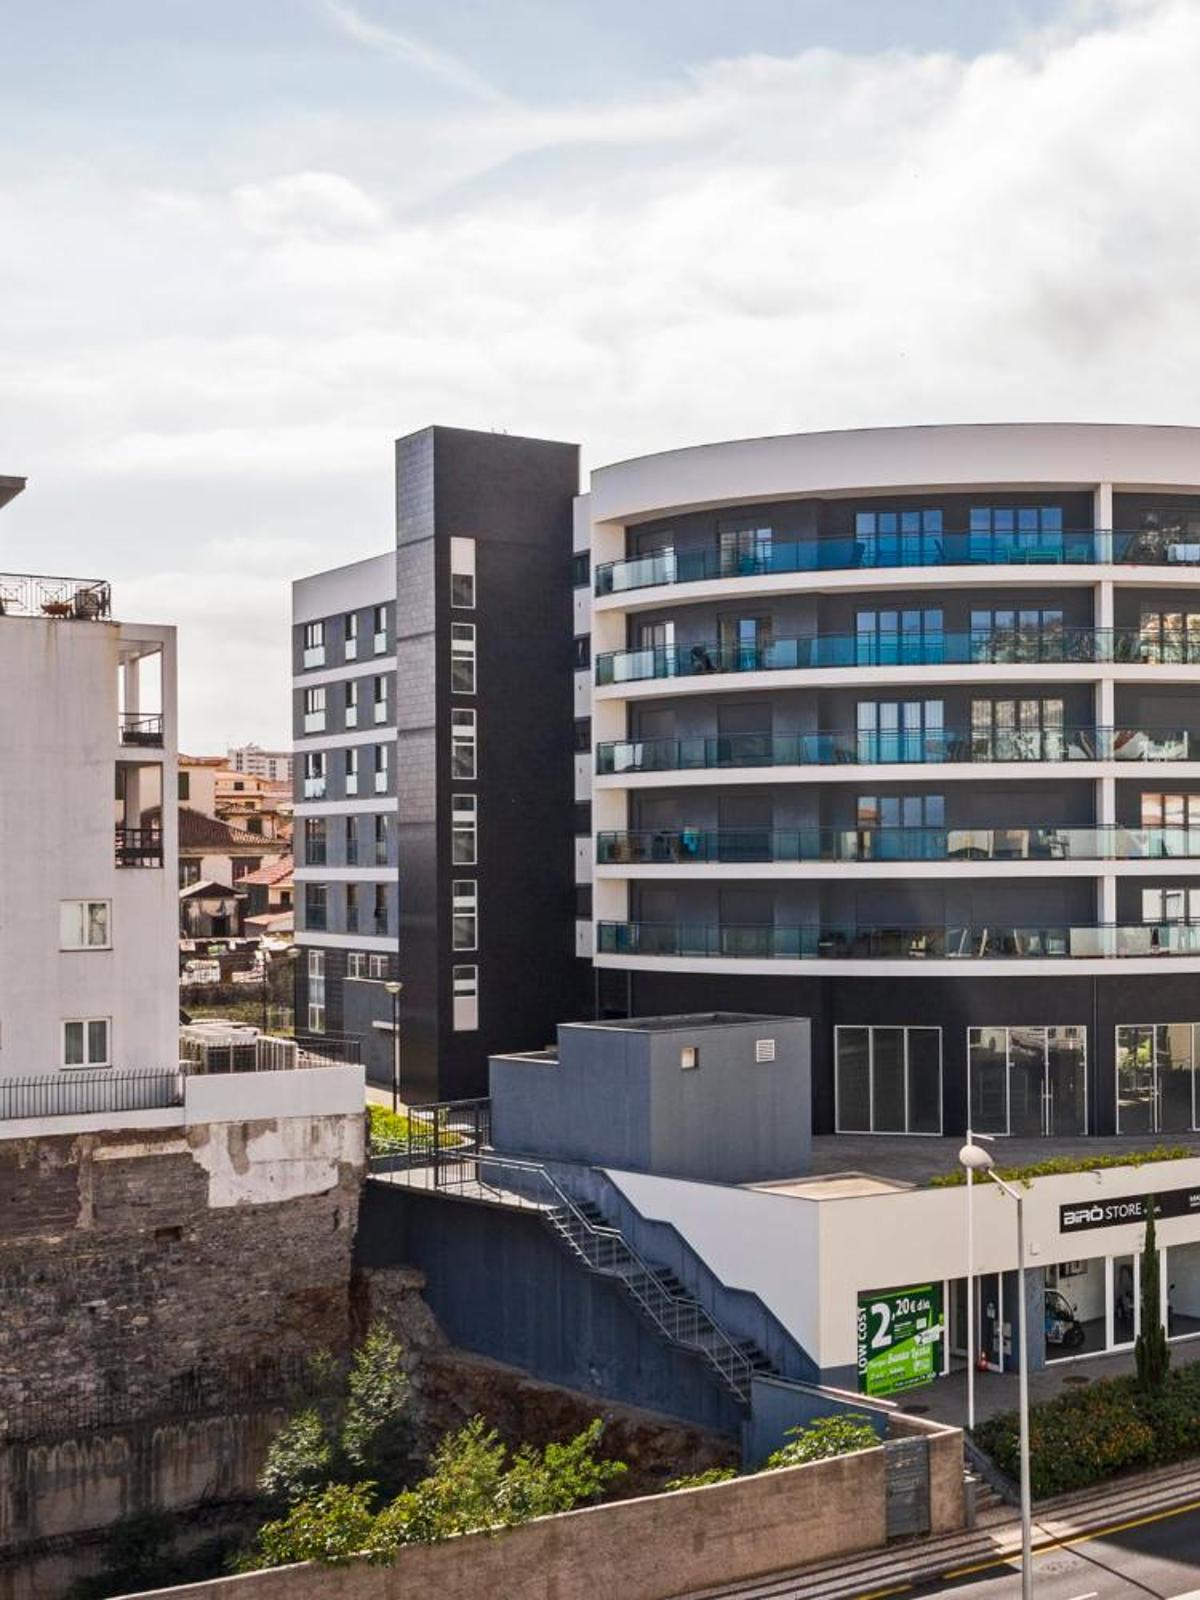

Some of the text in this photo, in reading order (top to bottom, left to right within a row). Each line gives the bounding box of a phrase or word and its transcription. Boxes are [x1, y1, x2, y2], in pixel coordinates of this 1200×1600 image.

[1105, 1202, 1142, 1220] STORE
[858, 1307, 868, 1375] LOW COST
